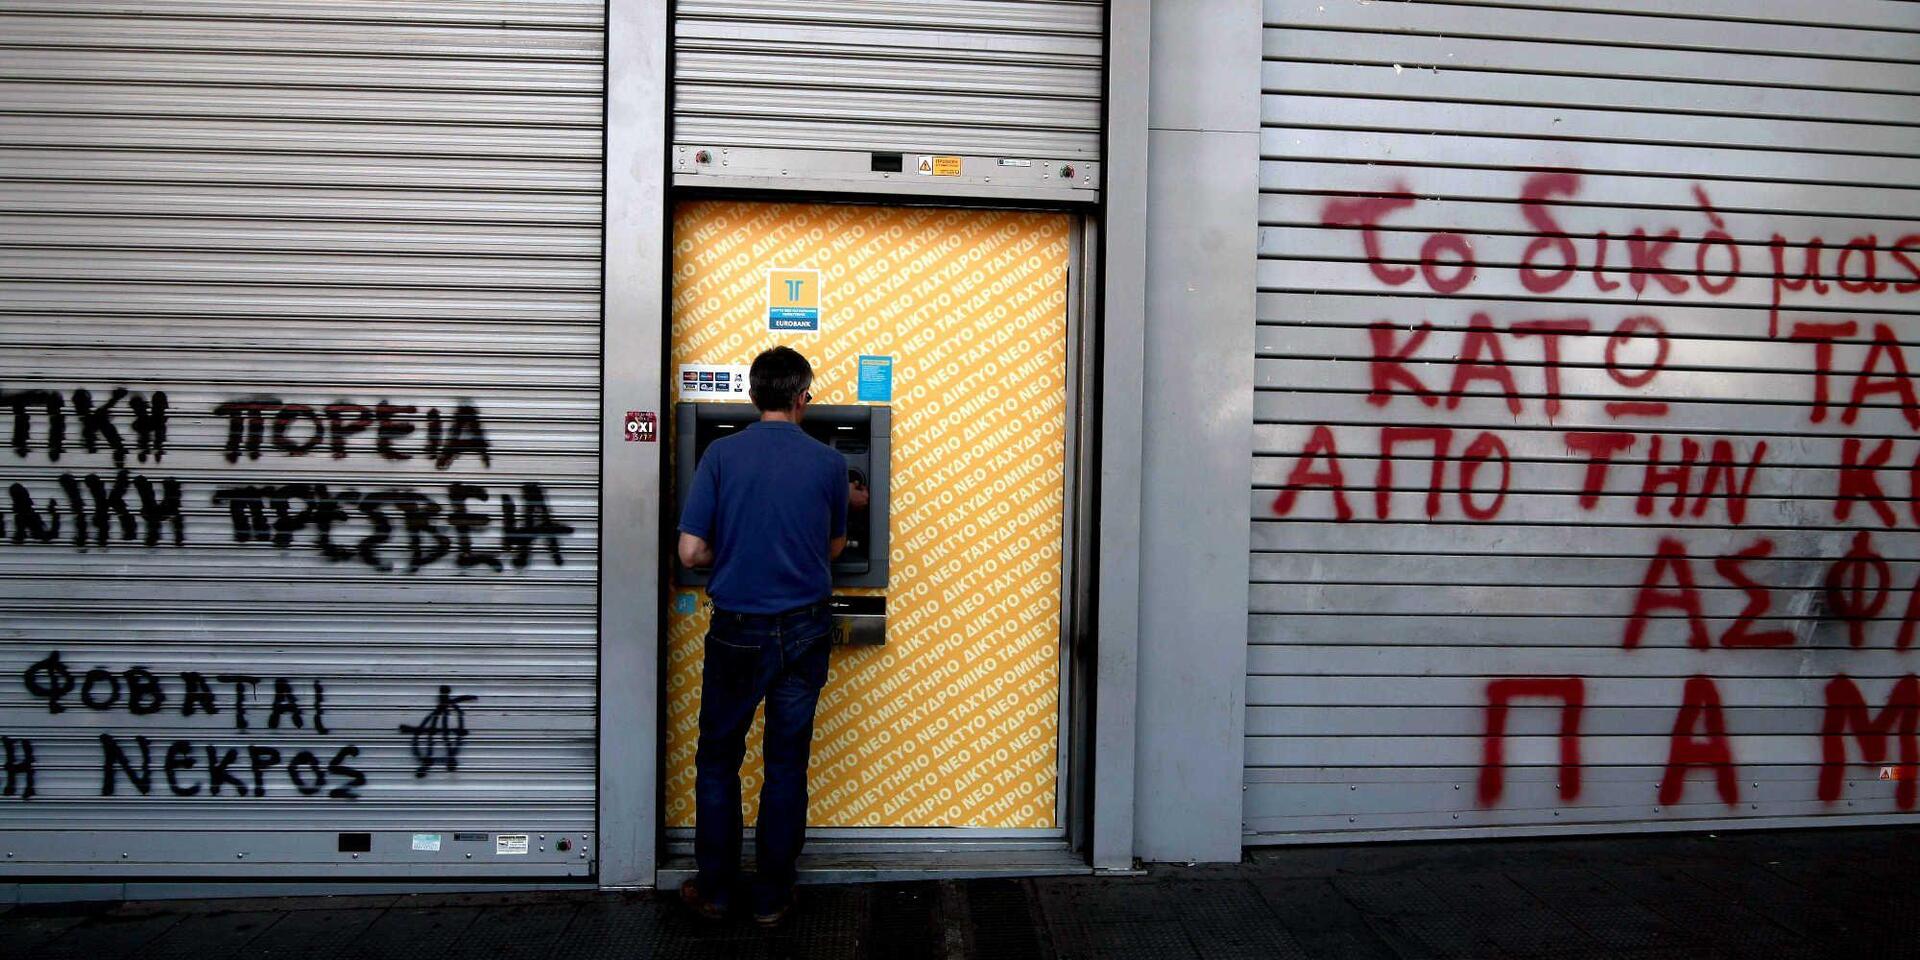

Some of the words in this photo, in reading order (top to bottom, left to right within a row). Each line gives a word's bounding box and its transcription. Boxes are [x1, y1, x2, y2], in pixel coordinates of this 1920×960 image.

[692, 214, 729, 244] ΝΕΟ
[748, 210, 809, 257] ΔΙΚΤΥΟ
[830, 222, 866, 252] ΝΕΟ
[843, 221, 904, 269] ΔΙΚΤΥΟ
[820, 304, 856, 334] ΝΕΟ
[854, 231, 963, 312] ΤΑΧΥΔΡΟΜΙΚΟ
[821, 314, 881, 361] ΔΙΚΤΥΟ
[878, 292, 914, 322] ΝΕΟ
[911, 220, 1020, 299] ΤΑΧΥΔΡΟΜΙΚΟ
[853, 256, 891, 287] ΝΕΟ
[892, 290, 953, 337] ΔΙΚΤΥΟ
[950, 268, 986, 298] ΝΕΟ
[901, 326, 937, 356] ΝΕΟ
[934, 253, 1043, 333] ΤΑΧΥΔΡΟΜΙΚΟ
[915, 325, 976, 372] ΔΙΚΤΥΟ
[973, 302, 1009, 333] ΝΕΟ
[924, 360, 961, 390] ΝΕΟ
[957, 287, 1066, 368] ΤΑΧΥΔΡΟΜΙΚΟ
[938, 360, 999, 407] ΔΙΚΤΥΟ
[996, 337, 1032, 368] ΝΕΟ
[213, 397, 490, 469] ΠΟΡΕΙΑ
[627, 421, 653, 433] ΟΧΙ
[891, 383, 1001, 464] ΤΑΧΥΔΡΟΜΙΚΟ
[959, 395, 1020, 442] ΔΙΚΤΥΟ
[1017, 372, 1052, 403] ΝΕΟ
[914, 417, 1024, 497] ΤΑΧΥΔΡΟΜΙΚΟ
[1272, 426, 1511, 522] ΑΠΟ
[1565, 433, 1767, 525] ΤΗΝ
[895, 488, 955, 535] ΔΙΚΤΥΟ
[952, 465, 988, 496] ΝΕΟ
[903, 523, 940, 554] ΝΕΟ
[936, 451, 1046, 532] ΤΑΧΥΔΡΟΜΙΚΟ
[918, 521, 979, 568] ΔΙΚΤΥΟ
[975, 498, 1012, 529] ΝΕΟ
[927, 556, 964, 587] ΝΕΟ
[939, 557, 999, 604] ΔΙΚΤΥΟ
[996, 534, 1033, 565] ΝΕΟ
[861, 630, 965, 707] ΤΑΜΙΕΥΤΗΡΙΟ
[962, 591, 1022, 638] ΔΙΚΤΥΟ
[1019, 569, 1054, 599] ΝΕΟ
[894, 613, 954, 660] ΔΙΚΤΥΟ
[951, 590, 987, 621] ΝΕΟ
[24, 650, 329, 735] ΦΟΒΑΤΑΙ
[857, 656, 963, 734] ΤΑΜΙΕΥΤΗΡΙΟ
[960, 617, 1020, 664] ΔΙΚΤΥΟ
[1017, 594, 1053, 625] ΝΕΟ
[856, 727, 892, 758] ΝΕΟ
[889, 655, 998, 736] ΤΑΧΥΔΡΟΜΙΚΟ
[857, 737, 917, 784] ΔΙΚΤΥΟ
[914, 714, 950, 745] ΝΕΟ
[947, 642, 1056, 723] ΤΑΧΥΔΡΟΜΙΚΟ
[928, 712, 988, 759] ΔΙΚΤΥΟ
[985, 690, 1021, 720] ΝΕΟ
[100, 733, 368, 799] ΝΕΚΡΟΣ
[880, 770, 940, 816] ΔΙΚΤΥΟ
[937, 747, 973, 778] ΝΕΟ
[950, 746, 1010, 792] ΔΙΚΤΥΟ
[1008, 722, 1044, 753] ΝΕΟ
[960, 780, 996, 810] ΝΕΟ
